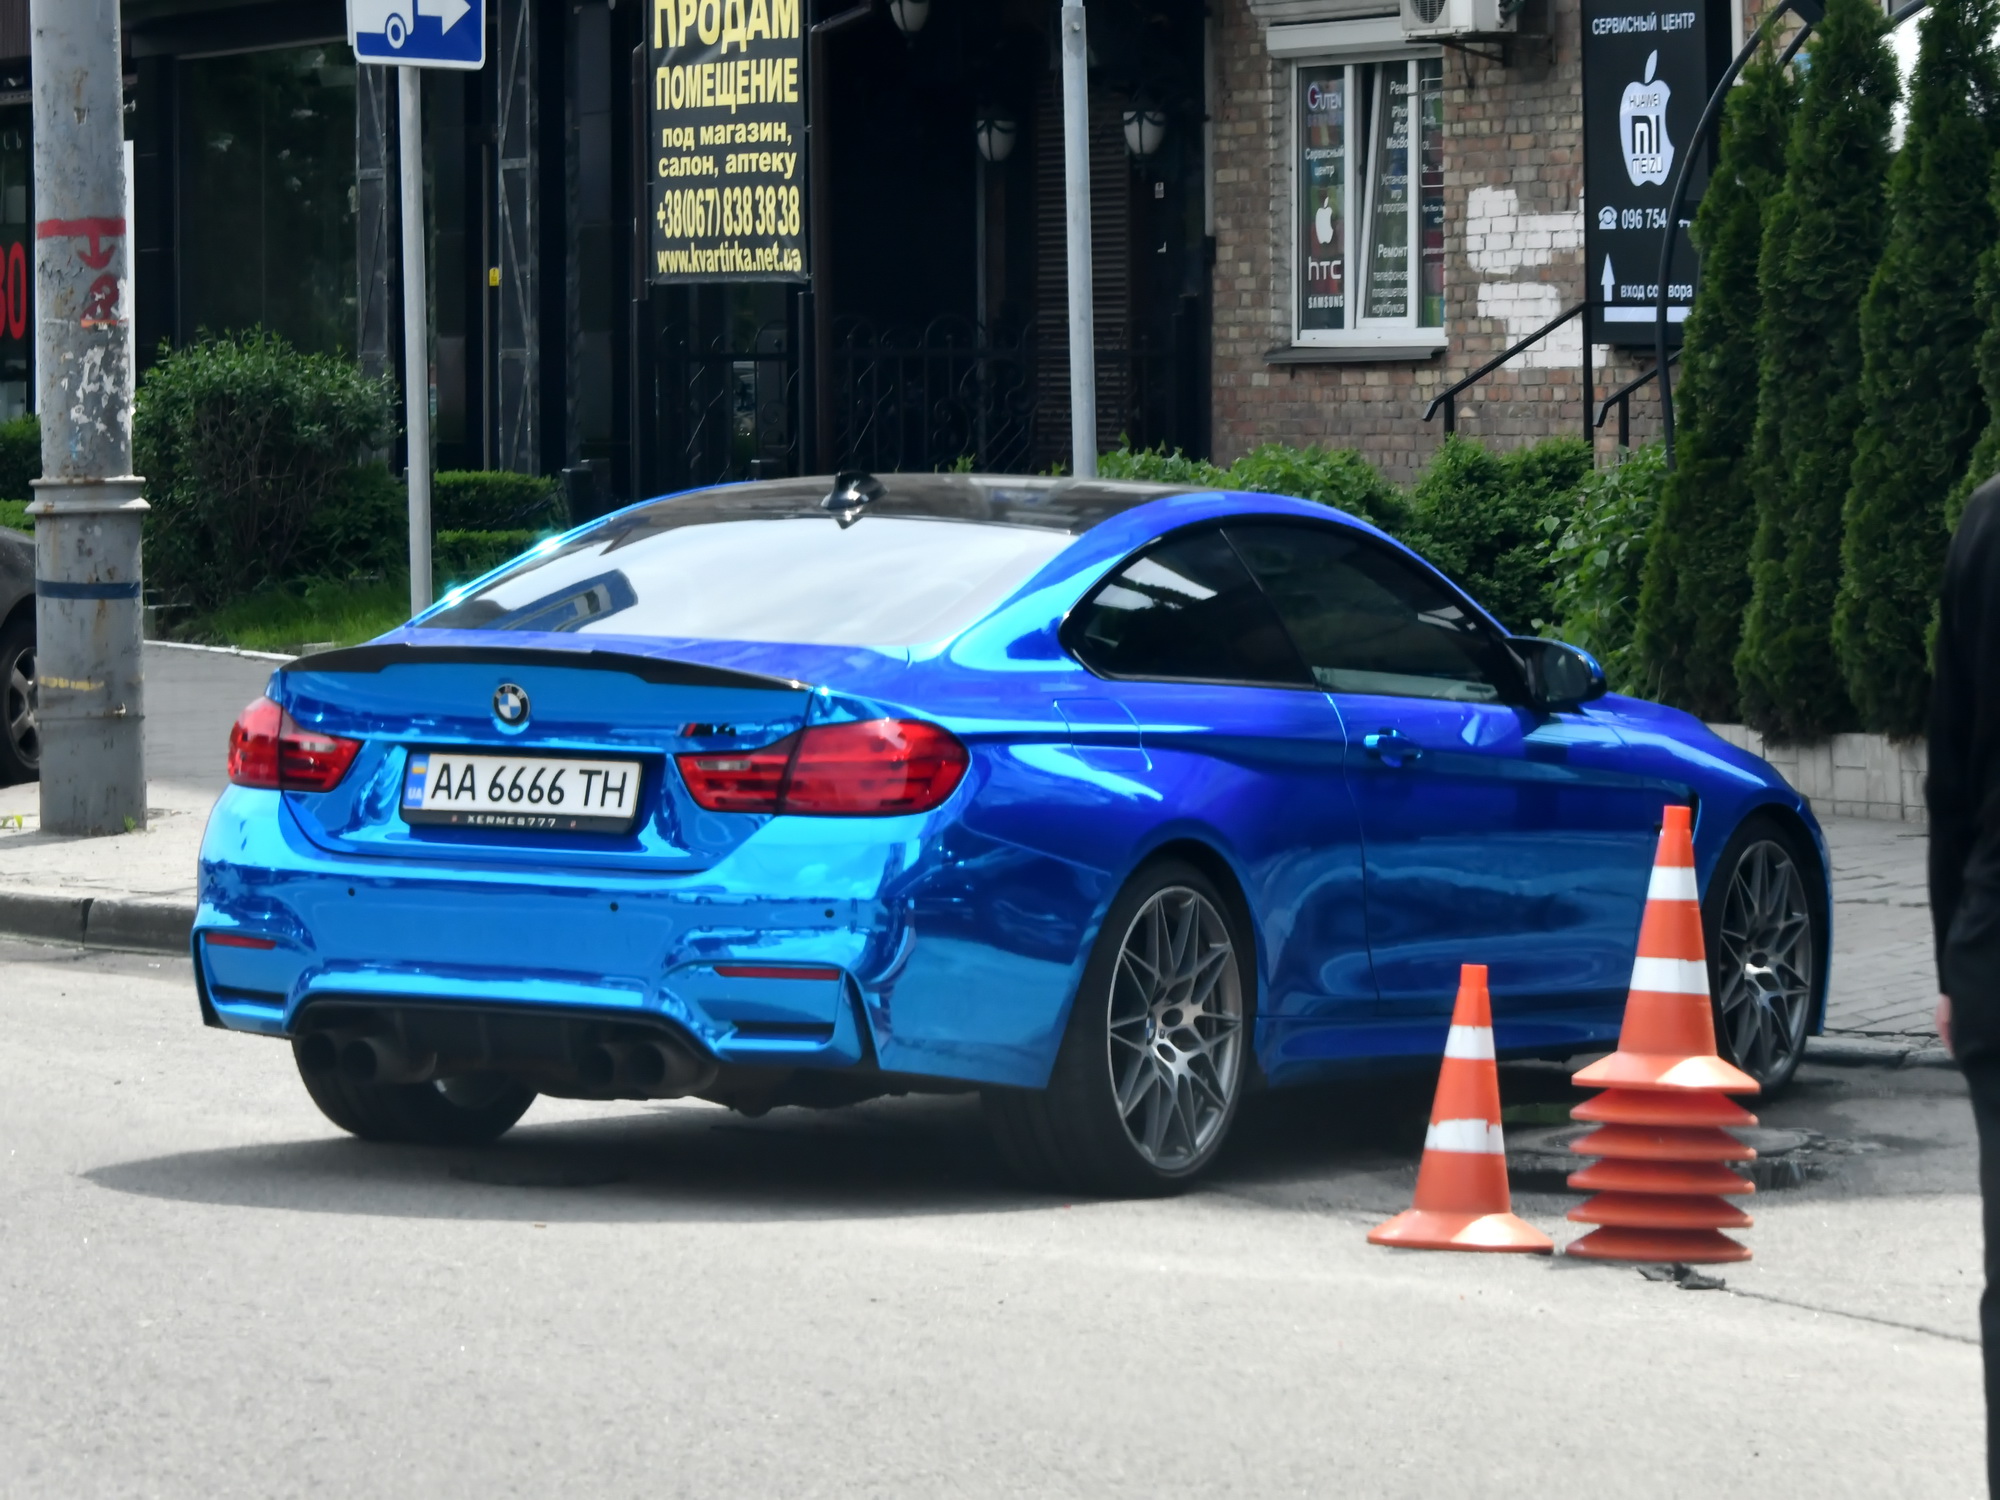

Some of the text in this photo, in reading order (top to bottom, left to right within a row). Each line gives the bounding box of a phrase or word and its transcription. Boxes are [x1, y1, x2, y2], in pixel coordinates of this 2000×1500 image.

[653, 0, 799, 54] ПРОДАМ
[1592, 12, 1696, 35] СЕРВИСНЫЙ ЦЕНТР
[656, 57, 798, 114] ПОМЕЩЕНИЕ
[1629, 92, 1660, 108] HUAWEI
[662, 121, 792, 151] под магазин,
[658, 151, 797, 179] салон, аптеку
[1632, 157, 1663, 174] MEIZU
[656, 185, 800, 238] +38(067) 838 38 38
[1621, 207, 1667, 230] 096 754
[656, 241, 801, 274] www.kvartirka.net.ua
[1308, 295, 1344, 309] SAMSUNG
[1621, 284, 1645, 300] вход
[1663, 284, 1693, 301] вора
[407, 787, 423, 800] UA
[431, 762, 628, 808] AA 6666 TH
